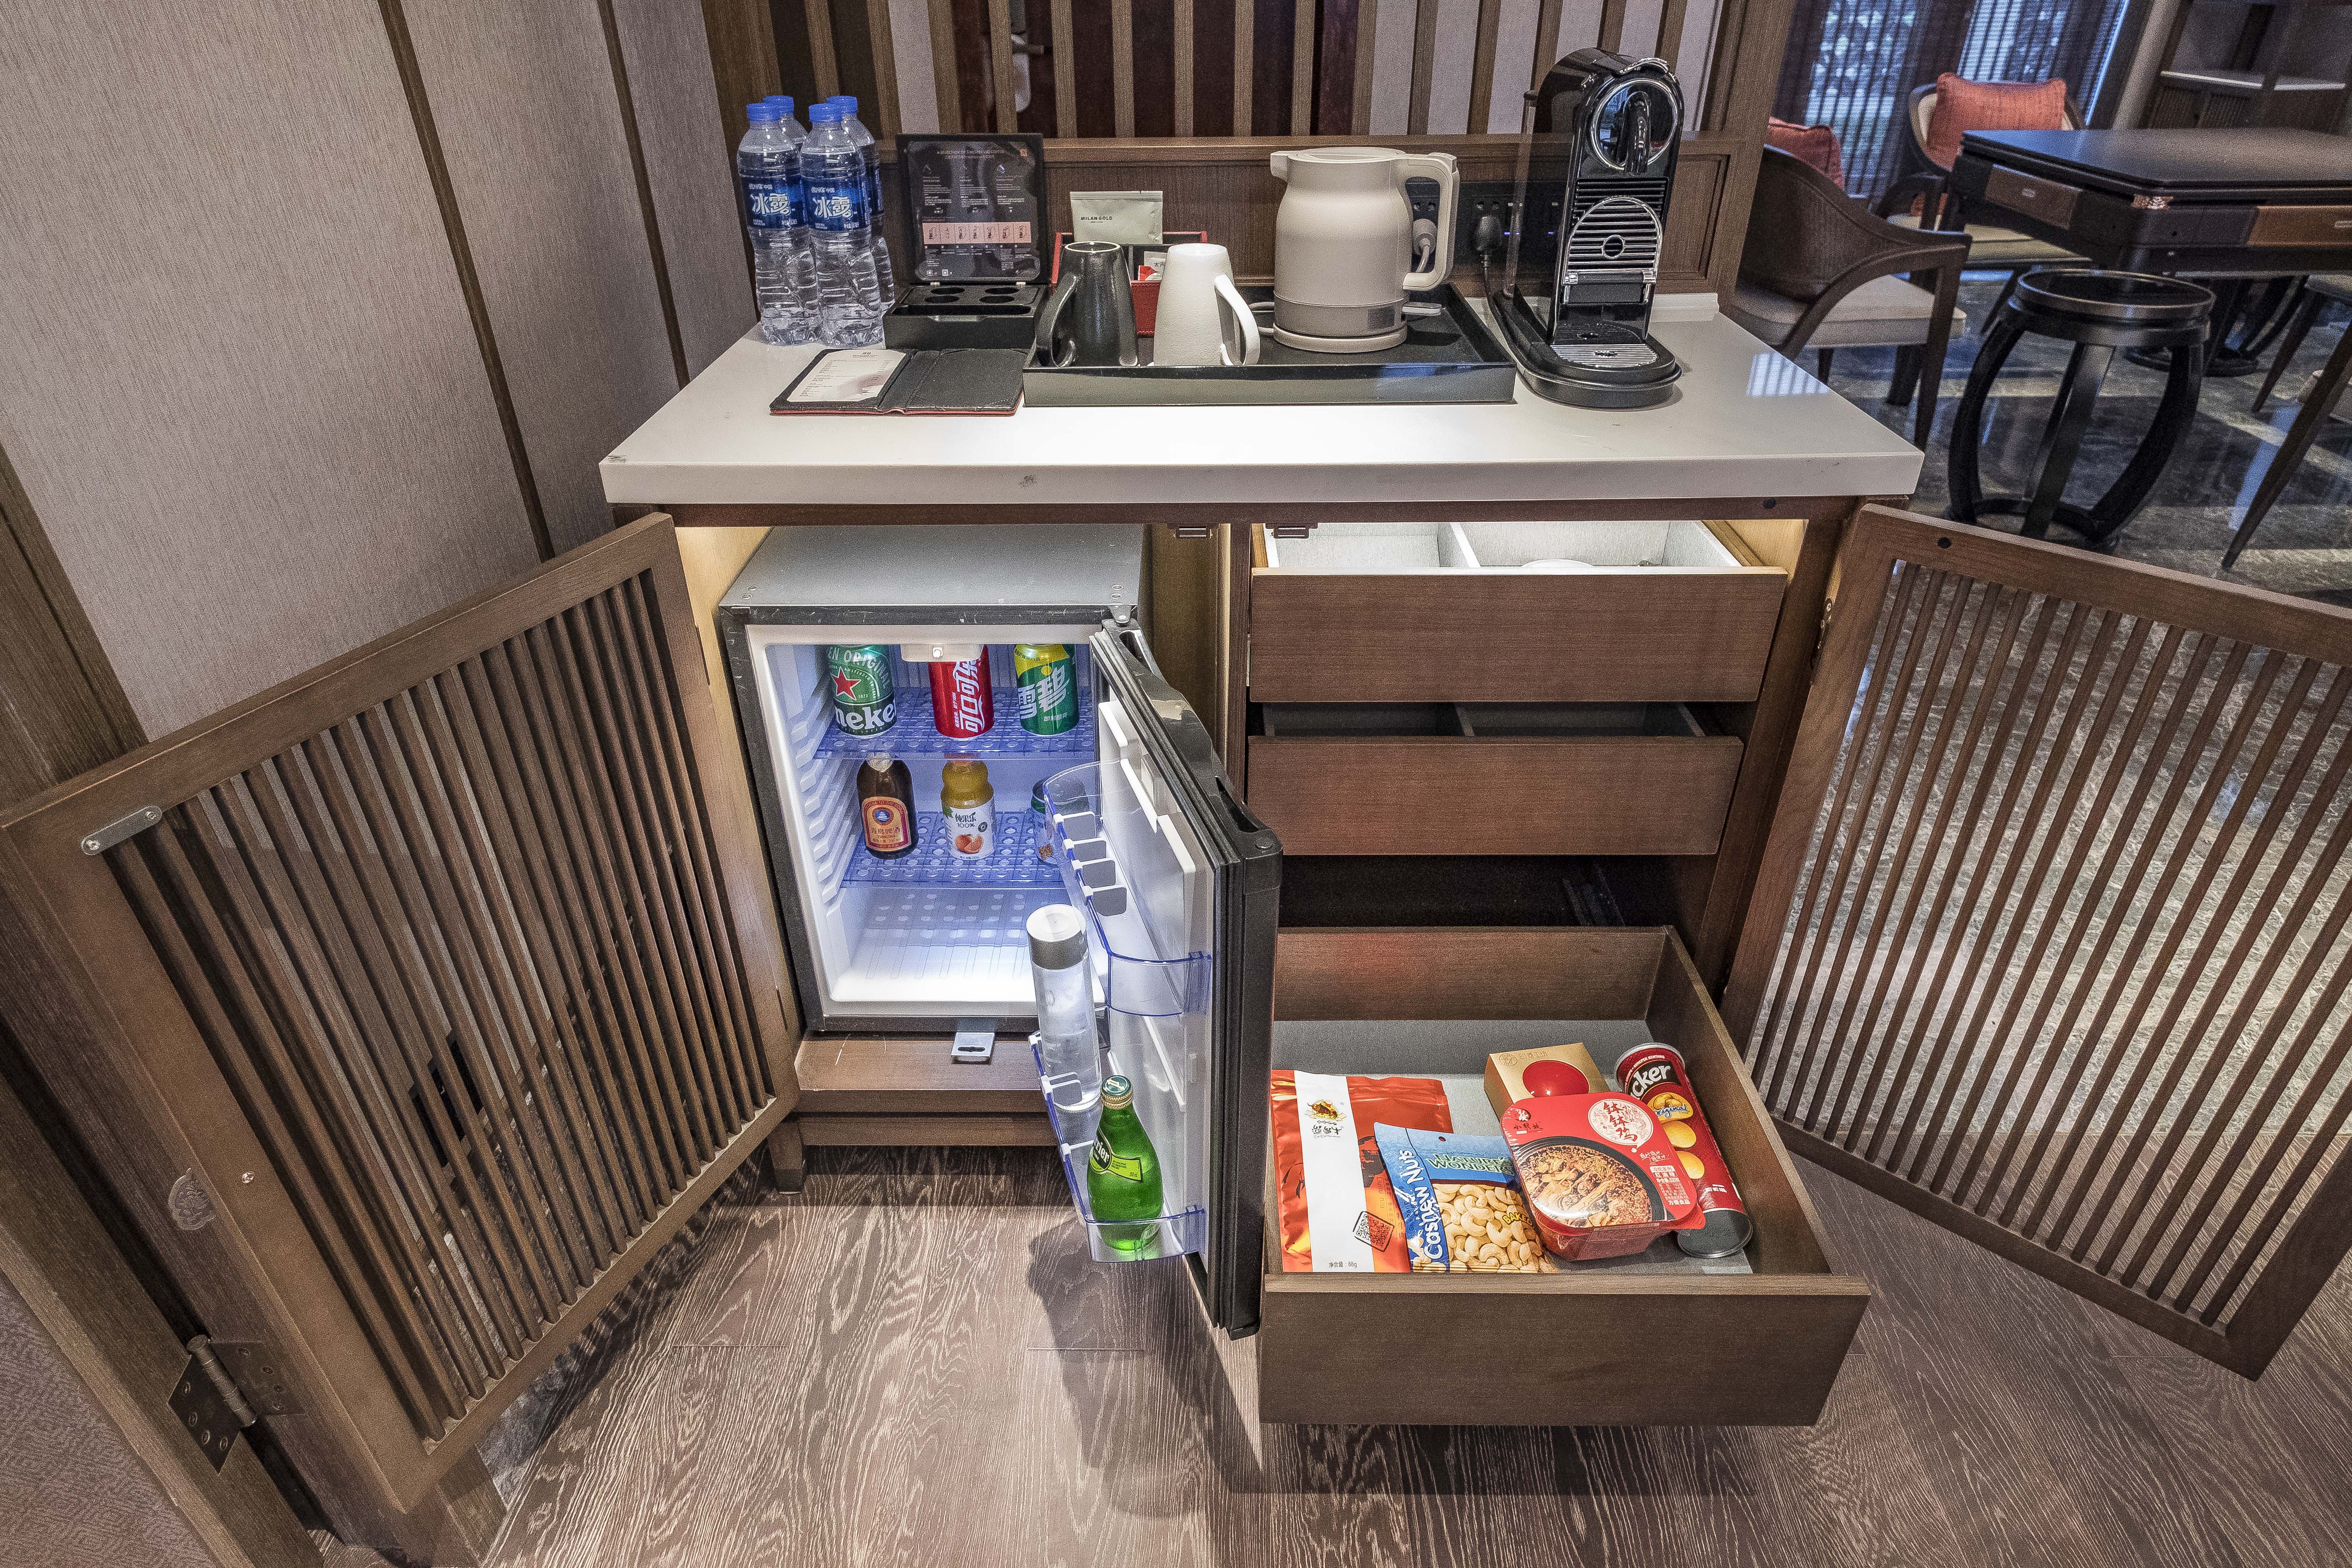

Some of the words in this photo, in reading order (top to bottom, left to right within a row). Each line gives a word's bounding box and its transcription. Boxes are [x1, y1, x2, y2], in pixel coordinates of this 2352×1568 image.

[750, 193, 790, 216] 冰露
[812, 196, 852, 218] 冰露
[843, 650, 890, 690] ORIGINAL
[1018, 664, 1070, 720] 雪碧
[834, 699, 896, 730] neke
[1603, 1102, 1638, 1142] 钵钵鸡
[1398, 1149, 1424, 1184] Nuts
[1426, 1158, 1514, 1176] WONDERS
[1433, 1153, 1512, 1167] NATURE'S
[1414, 1186, 1443, 1259] Cashew
[1502, 1212, 1533, 1226] BAKED
